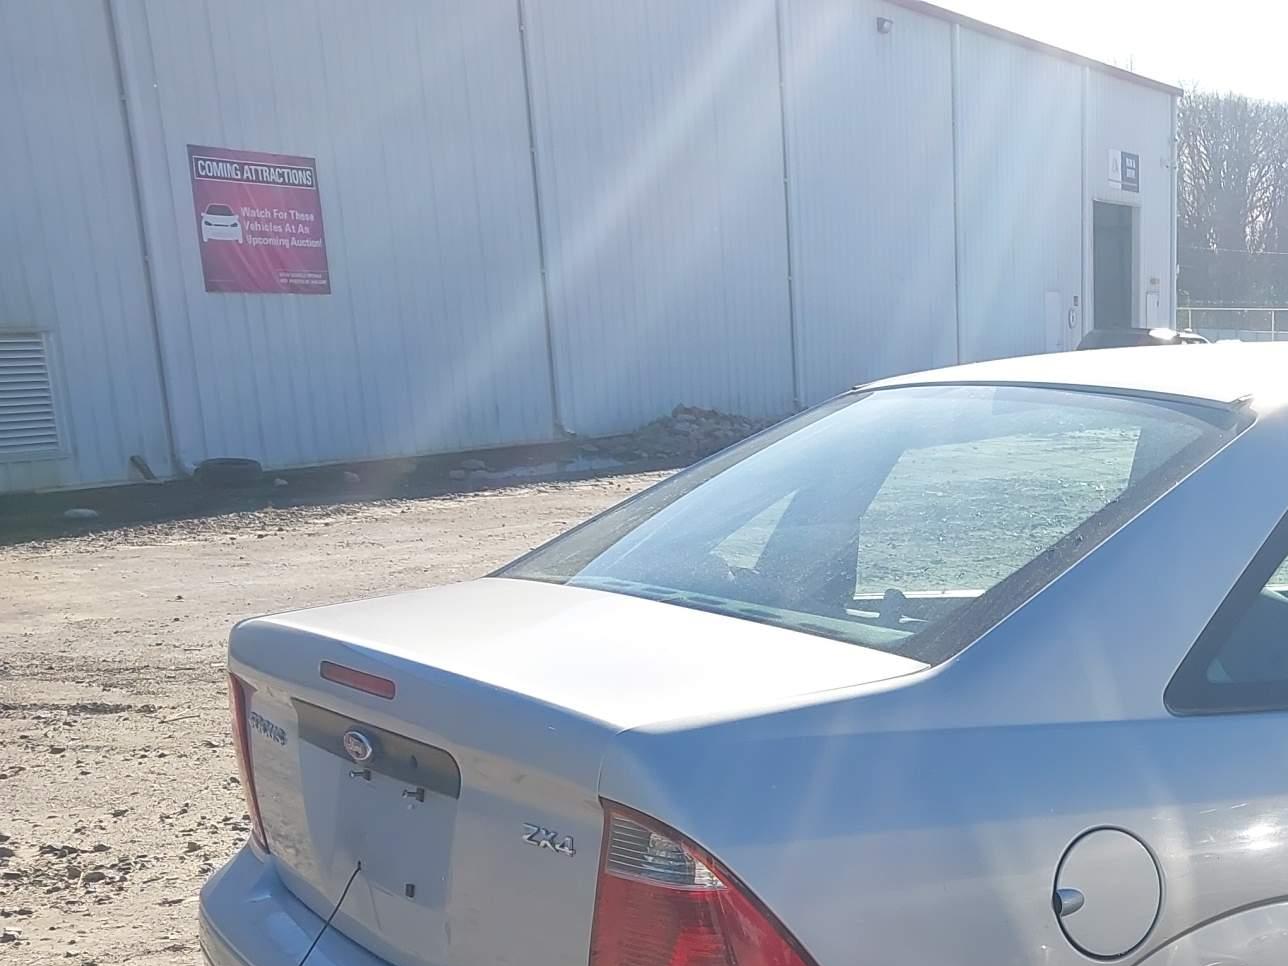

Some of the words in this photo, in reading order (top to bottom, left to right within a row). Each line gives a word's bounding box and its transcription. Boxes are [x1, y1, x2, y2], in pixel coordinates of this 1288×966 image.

[198, 160, 241, 179] COMING
[243, 165, 312, 185] ATTRACTIONS
[240, 207, 271, 219] Watch
[273, 208, 288, 220] For
[288, 210, 314, 221] These
[244, 220, 283, 233] Vehicles
[285, 223, 297, 234] At
[246, 235, 290, 248] Upcoming
[521, 822, 577, 857] ZX4
